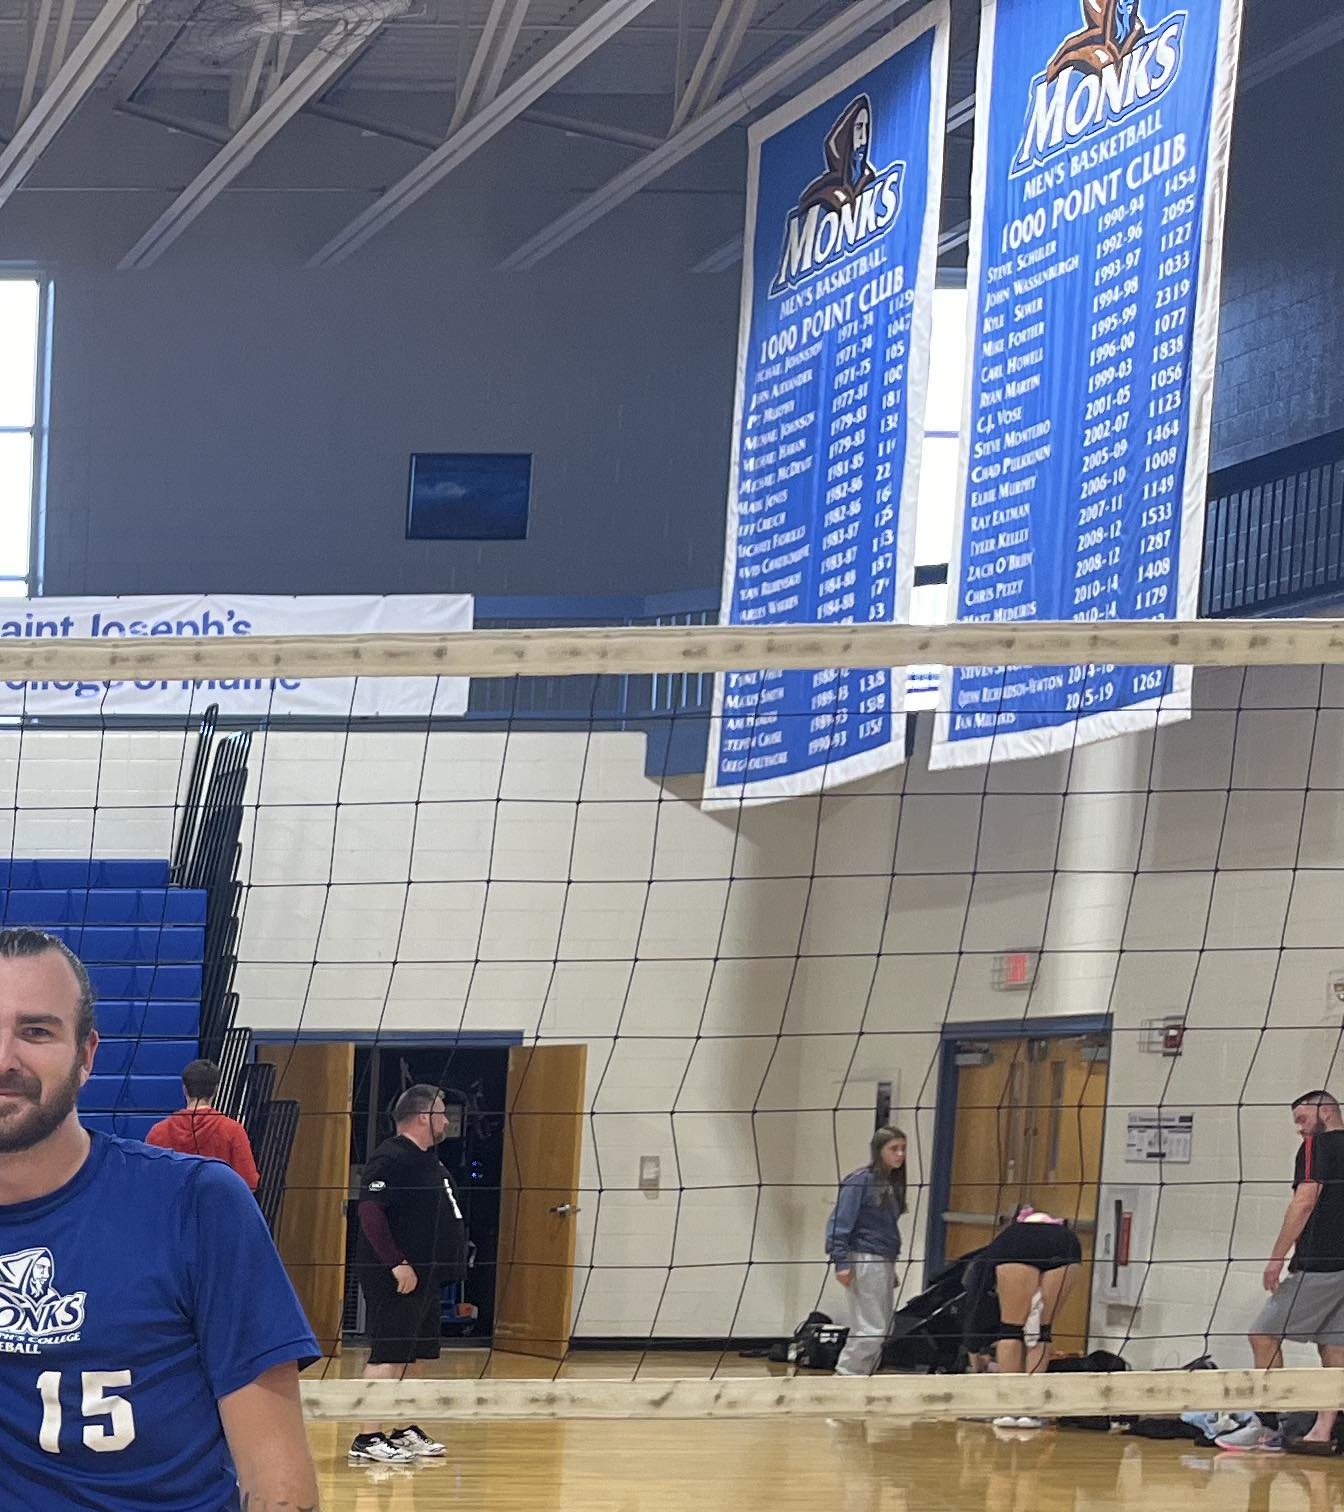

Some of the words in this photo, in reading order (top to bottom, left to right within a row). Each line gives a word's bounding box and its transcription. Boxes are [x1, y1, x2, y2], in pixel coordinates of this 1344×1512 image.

[1016, 21, 1181, 165] MONKS
[1023, 161, 1065, 202] MEN'S
[1069, 109, 1163, 178] BASKETBALL
[1001, 207, 1047, 254] 1000
[1051, 168, 1123, 229] POINT
[1125, 132, 1187, 189] CLUB
[1097, 194, 1145, 233] 1990-94
[1164, 165, 1197, 197] 1454
[777, 171, 900, 285] MONKS
[1094, 248, 1142, 286] 1993-97
[1161, 221, 1193, 253] 1127
[1096, 221, 1143, 259] 1992-96
[1162, 194, 1195, 226] 2095
[779, 290, 812, 320] MEN'S
[815, 244, 888, 300] BASKETBALL
[1091, 304, 1138, 340] 1995-99
[1155, 279, 1191, 309] 2319
[1092, 276, 1139, 313] 1994-98
[1158, 251, 1190, 280] 1033
[760, 325, 798, 364] 1000
[801, 292, 855, 345] POINT
[858, 265, 905, 312] CLUB
[1089, 331, 1136, 367] 1996-00
[1154, 306, 1187, 336] 1077
[1085, 385, 1131, 421] 2001-05
[1151, 362, 1183, 391] 1056
[1088, 358, 1133, 393] 1999-03
[1153, 335, 1185, 364] 1838
[1082, 439, 1128, 473] 2005-09
[1146, 419, 1180, 446] 1464
[1083, 411, 1130, 447] 2002-07
[1149, 390, 1182, 418] 1123
[1078, 494, 1123, 526] 2007-11
[1142, 474, 1175, 501] 1149
[1080, 466, 1127, 500] 2006-10
[1144, 447, 1177, 473] 1008
[1075, 547, 1121, 579] 2008-12
[1139, 529, 1172, 554] 1287
[1076, 520, 1123, 553] 2008-12
[1141, 502, 1173, 528] 1533
[1073, 574, 1120, 605] 2010-14
[1137, 557, 1171, 583] 1408
[1135, 585, 1169, 611] 1179
[1132, 669, 1163, 694] 1262
[36, 1369, 136, 1454] 15
